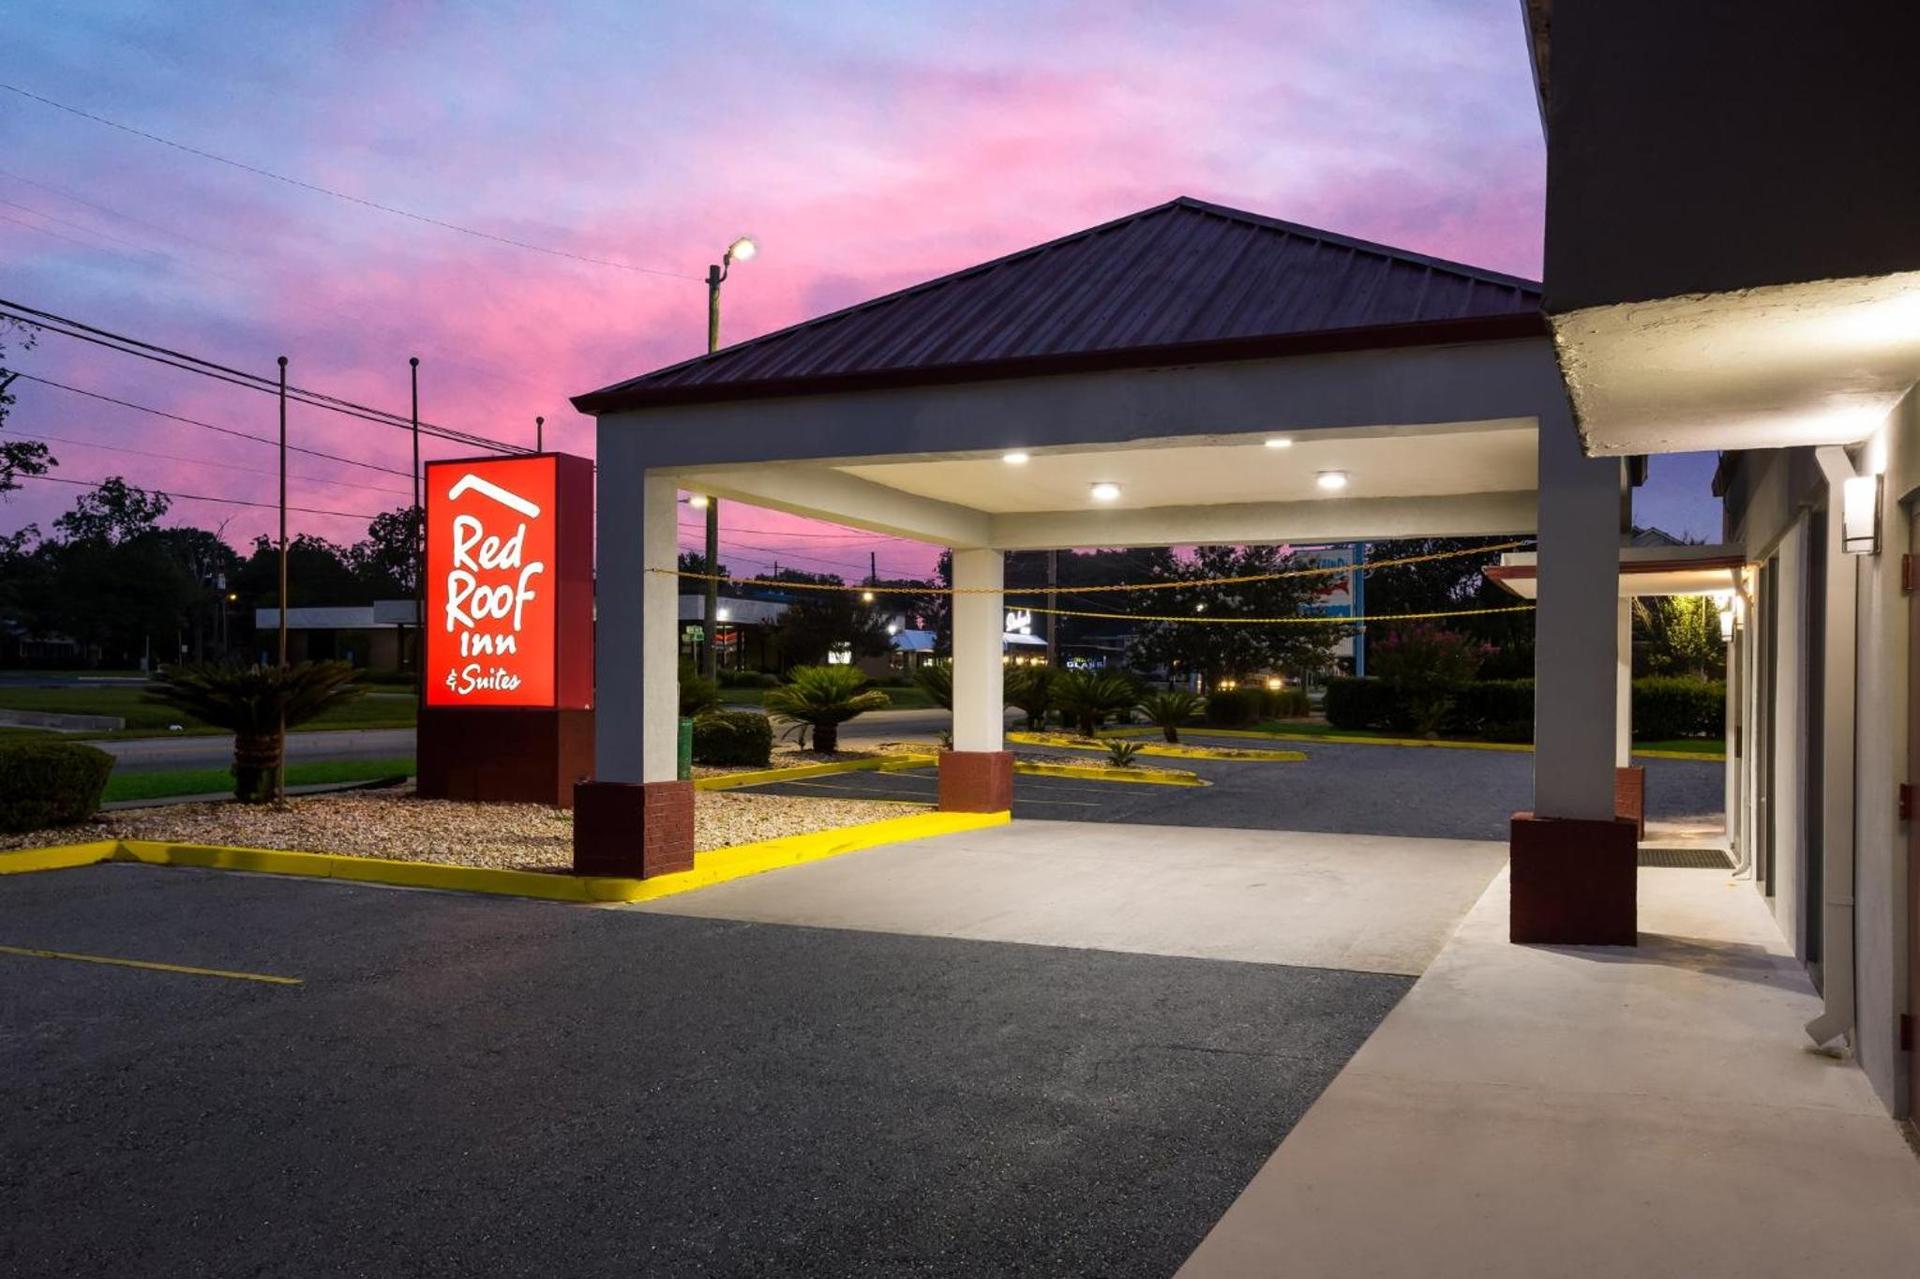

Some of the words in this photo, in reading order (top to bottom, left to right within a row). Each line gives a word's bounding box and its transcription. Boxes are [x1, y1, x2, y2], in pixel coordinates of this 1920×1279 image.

[453, 514, 526, 572] Red
[446, 561, 544, 632] Roof
[446, 668, 457, 691] &
[458, 663, 521, 695] Suites
